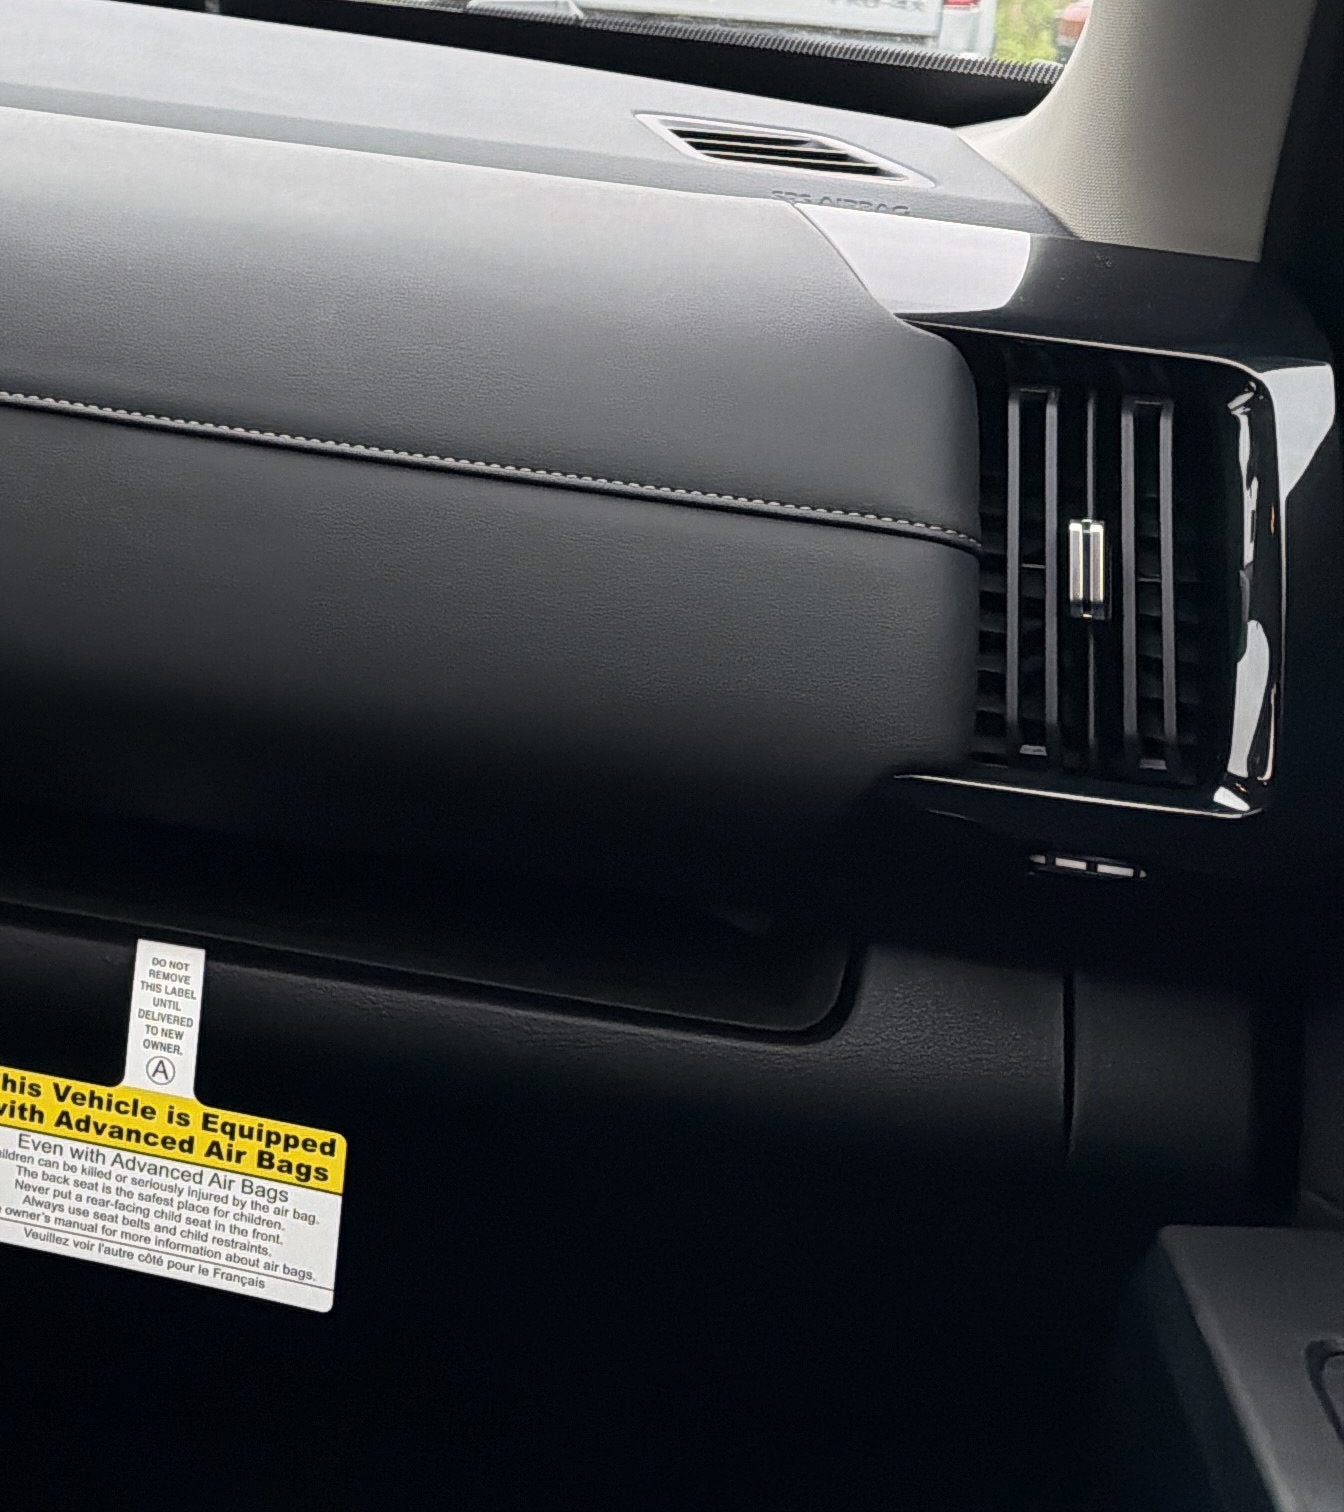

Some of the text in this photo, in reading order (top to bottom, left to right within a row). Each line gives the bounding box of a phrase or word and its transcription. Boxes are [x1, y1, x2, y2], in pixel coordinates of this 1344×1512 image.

[140, 980, 197, 1000] THIS LABEL
[149, 969, 191, 985] REMOVE
[152, 957, 190, 971] DO NOT
[138, 1008, 194, 1028] DELIVERED
[145, 1024, 184, 1040] TO NEW
[153, 997, 181, 1011] UNTIL
[143, 1039, 183, 1056] OWNER.
[52, 1082, 157, 1120] Vehicle
[166, 1105, 191, 1127] is
[202, 1112, 337, 1157] Equipped
[54, 1110, 195, 1155] Advanced
[204, 1140, 247, 1164] Air
[257, 1150, 329, 1182] Bags
[16, 1165, 285, 1231] The back seat is the safest place for children.
[18, 1132, 289, 1203] Even with Advanced Air Bags
[37, 1157, 59, 1170] can
[63, 1160, 77, 1173] be
[81, 1167, 111, 1181] killed
[115, 1174, 127, 1184] or
[130, 1176, 184, 1197] seriously
[187, 1183, 229, 1205] injured
[232, 1194, 247, 1210] by
[251, 1201, 269, 1213] the
[273, 1204, 289, 1218] air
[293, 1211, 320, 1226] bag.
[15, 1179, 283, 1245] Never put a rear-facing child seat in the front.
[22, 1195, 272, 1257] Always use seat belts and child restraints.
[5, 1207, 51, 1223] owner's
[54, 1216, 98, 1234] manual
[101, 1225, 117, 1237] for
[120, 1231, 151, 1244] more
[154, 1236, 222, 1260] information
[225, 1253, 260, 1268] about
[263, 1260, 280, 1272] air
[282, 1265, 316, 1281] bags.
[24, 1227, 266, 1289] Veuillez voir l'autre côté pour le Français
